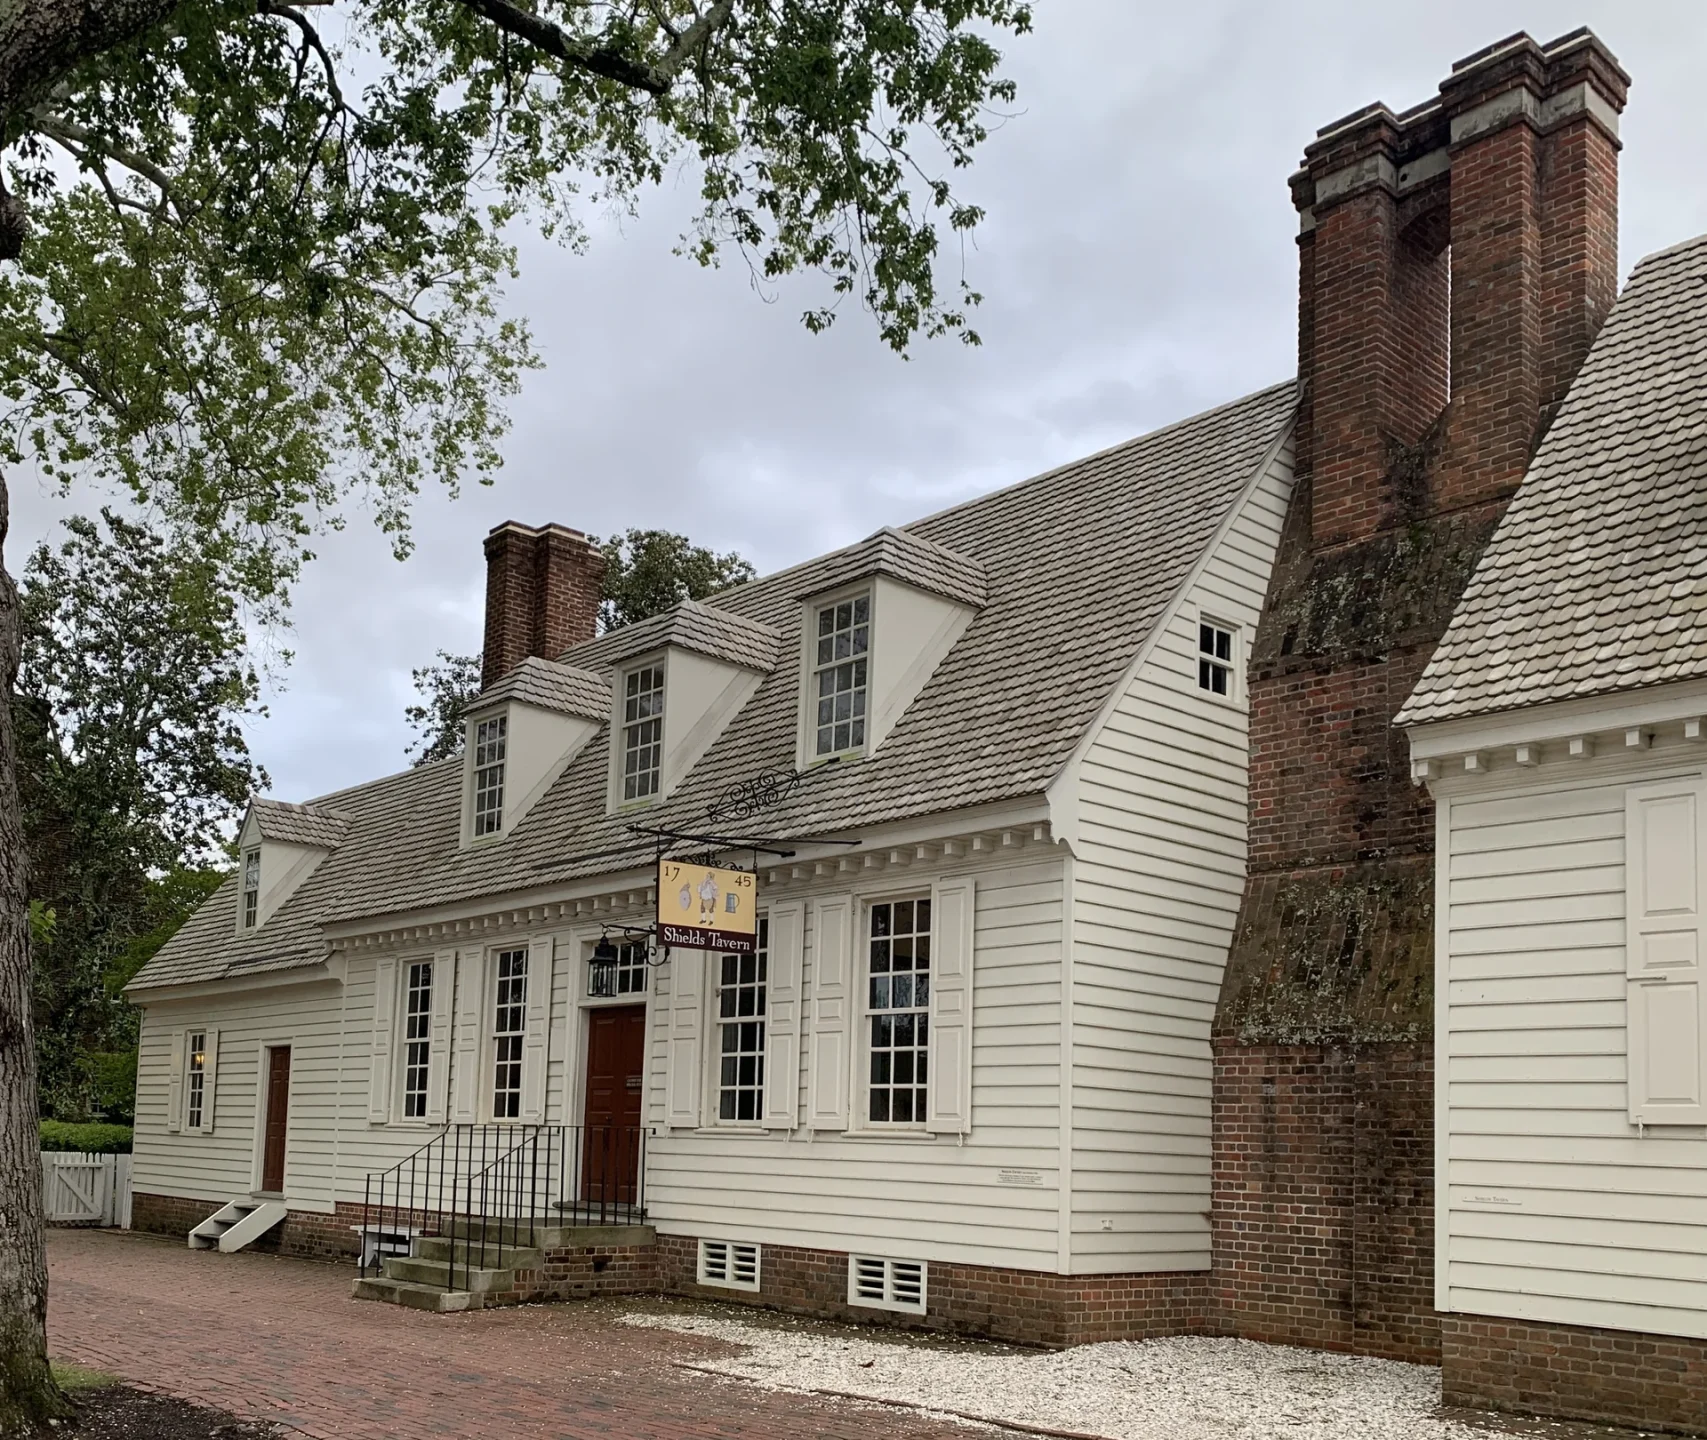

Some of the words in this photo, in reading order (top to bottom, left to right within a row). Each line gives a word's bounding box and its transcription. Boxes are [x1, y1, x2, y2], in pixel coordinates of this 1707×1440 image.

[664, 865, 681, 882] 17
[734, 874, 752, 888] 45
[663, 926, 706, 946] Shields
[708, 931, 751, 951] Tavern
